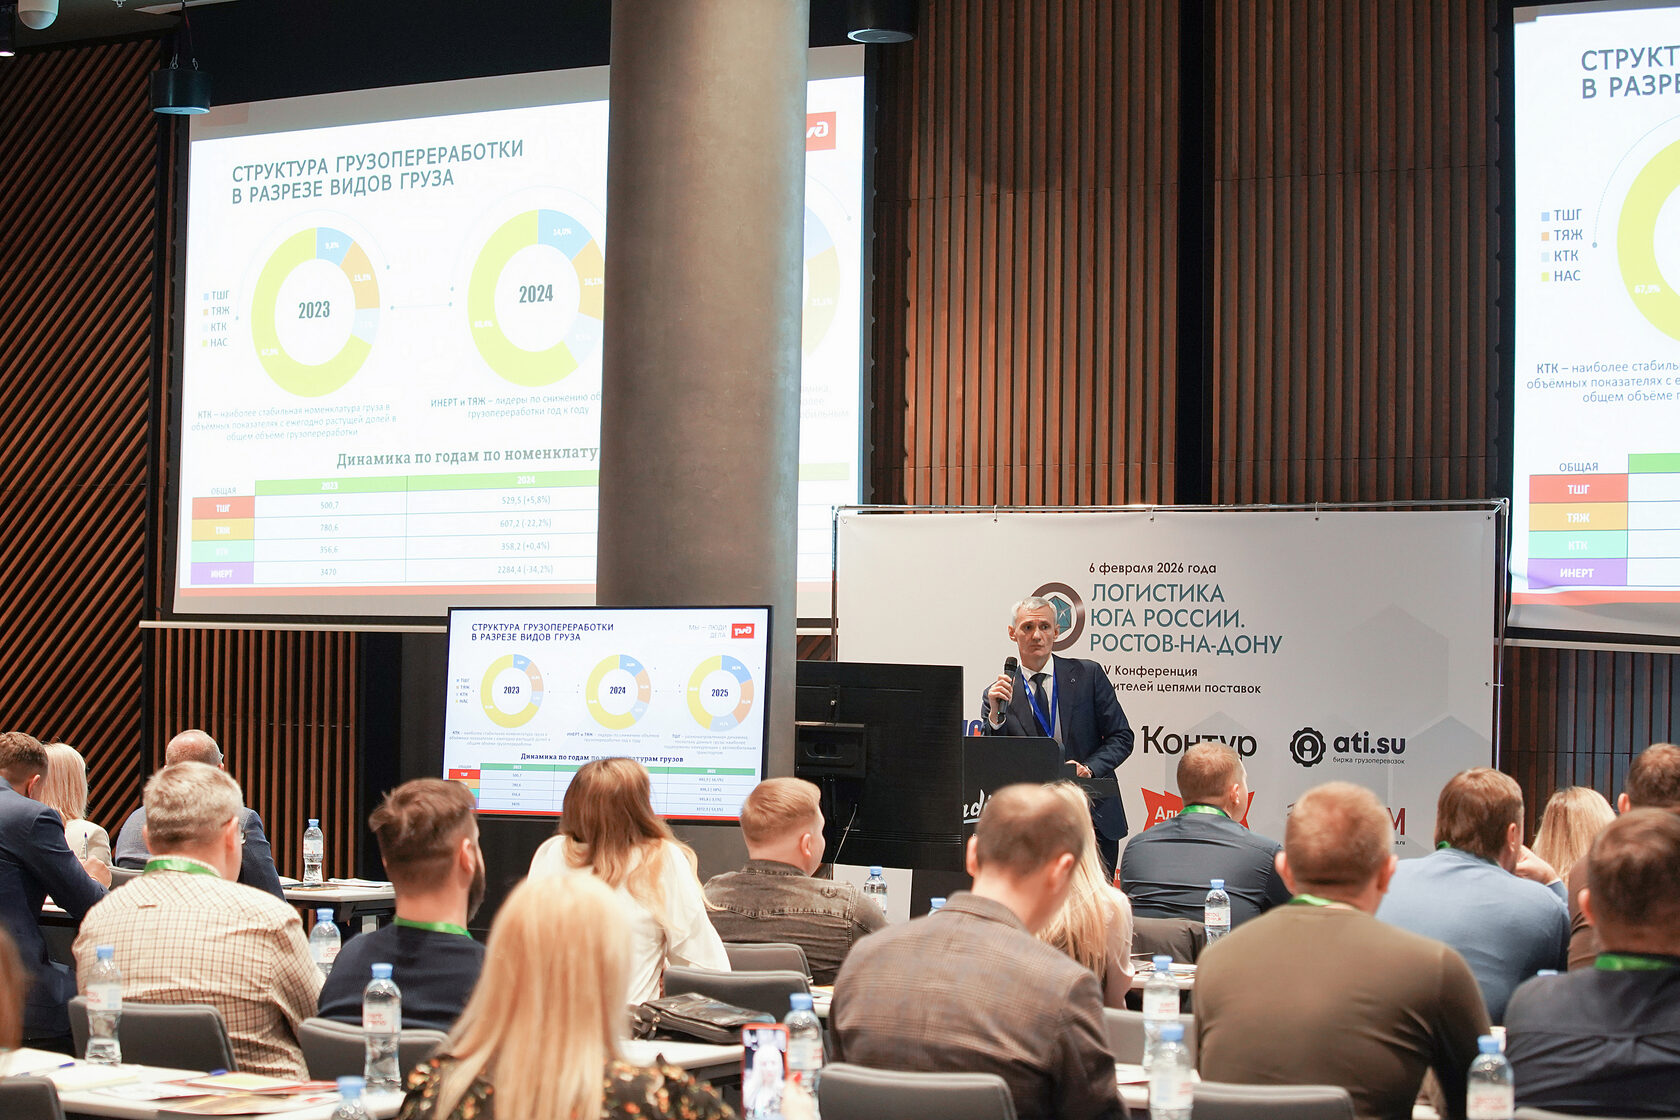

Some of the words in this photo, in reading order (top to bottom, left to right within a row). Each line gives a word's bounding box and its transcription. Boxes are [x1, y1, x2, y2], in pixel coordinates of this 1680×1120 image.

[1582, 79, 1597, 99] В
[232, 158, 328, 182] СТРУКТУРА
[336, 140, 524, 172] ГРУЗОПЕРЕРАБОТКИ
[232, 188, 243, 204] В
[250, 180, 323, 202] РАЗРЕЗЕ
[330, 175, 392, 196] ВИДОВ
[400, 169, 454, 190] ГРУЗА
[1553, 209, 1582, 221] ТШГ
[1553, 229, 1583, 241] ТЯЖ
[1554, 250, 1579, 262] КТК
[1554, 270, 1581, 282] НАС
[211, 290, 229, 301] ТШГ
[519, 284, 553, 303] 2024
[211, 305, 230, 317] ТЯЖ
[298, 300, 331, 320] 2023
[210, 321, 227, 332] КТК
[210, 337, 228, 348] НАС
[1536, 363, 1559, 374] КТК
[1572, 361, 1629, 373] наиболее
[1526, 377, 1587, 389] объёмных
[1591, 376, 1662, 387] показателях
[431, 398, 458, 408] ИНЕРТ
[467, 396, 486, 406] ТЯЖ
[1582, 391, 1624, 403] общем
[1627, 390, 1673, 402] объёме
[468, 407, 545, 420] грузопереработки
[337, 453, 411, 469] Динамика
[415, 453, 431, 464] по
[435, 451, 479, 465] годам
[483, 450, 501, 462] по
[504, 447, 599, 462] номенклату
[1559, 462, 1599, 474] ОБЩАЯ
[1567, 484, 1591, 495] ТШГ
[1566, 512, 1591, 524] ТЯЖ
[1568, 540, 1588, 550] КТК
[1089, 563, 1096, 573] 6
[1099, 562, 1153, 575] февраля
[1157, 563, 1184, 574] 2026
[1187, 564, 1217, 575] года
[1559, 568, 1595, 579] ИНЕРТ
[1091, 583, 1225, 602] ЛОГИСТИКА
[1090, 608, 1136, 627] ЮГА
[1144, 608, 1245, 628] РОССИИ.
[471, 623, 520, 631] СТРУКТУРА
[523, 623, 614, 632] ГРУЗОПЕРЕРАБОТКИ
[471, 633, 478, 641] В
[480, 633, 517, 641] РАЗРЕЗЕ
[520, 633, 551, 642] ВИДОВ
[554, 633, 581, 641] ГРУЗА
[1090, 633, 1283, 656] РОСТОВ-НА-ДОНУ
[1115, 665, 1198, 679] Конференция
[503, 685, 520, 695] 2023
[609, 686, 626, 695] 2024
[711, 688, 729, 698] 2025
[1157, 684, 1201, 694] цепями
[1204, 684, 1261, 694] поставок
[1333, 730, 1406, 754] ati.su
[568, 754, 590, 762] годам
